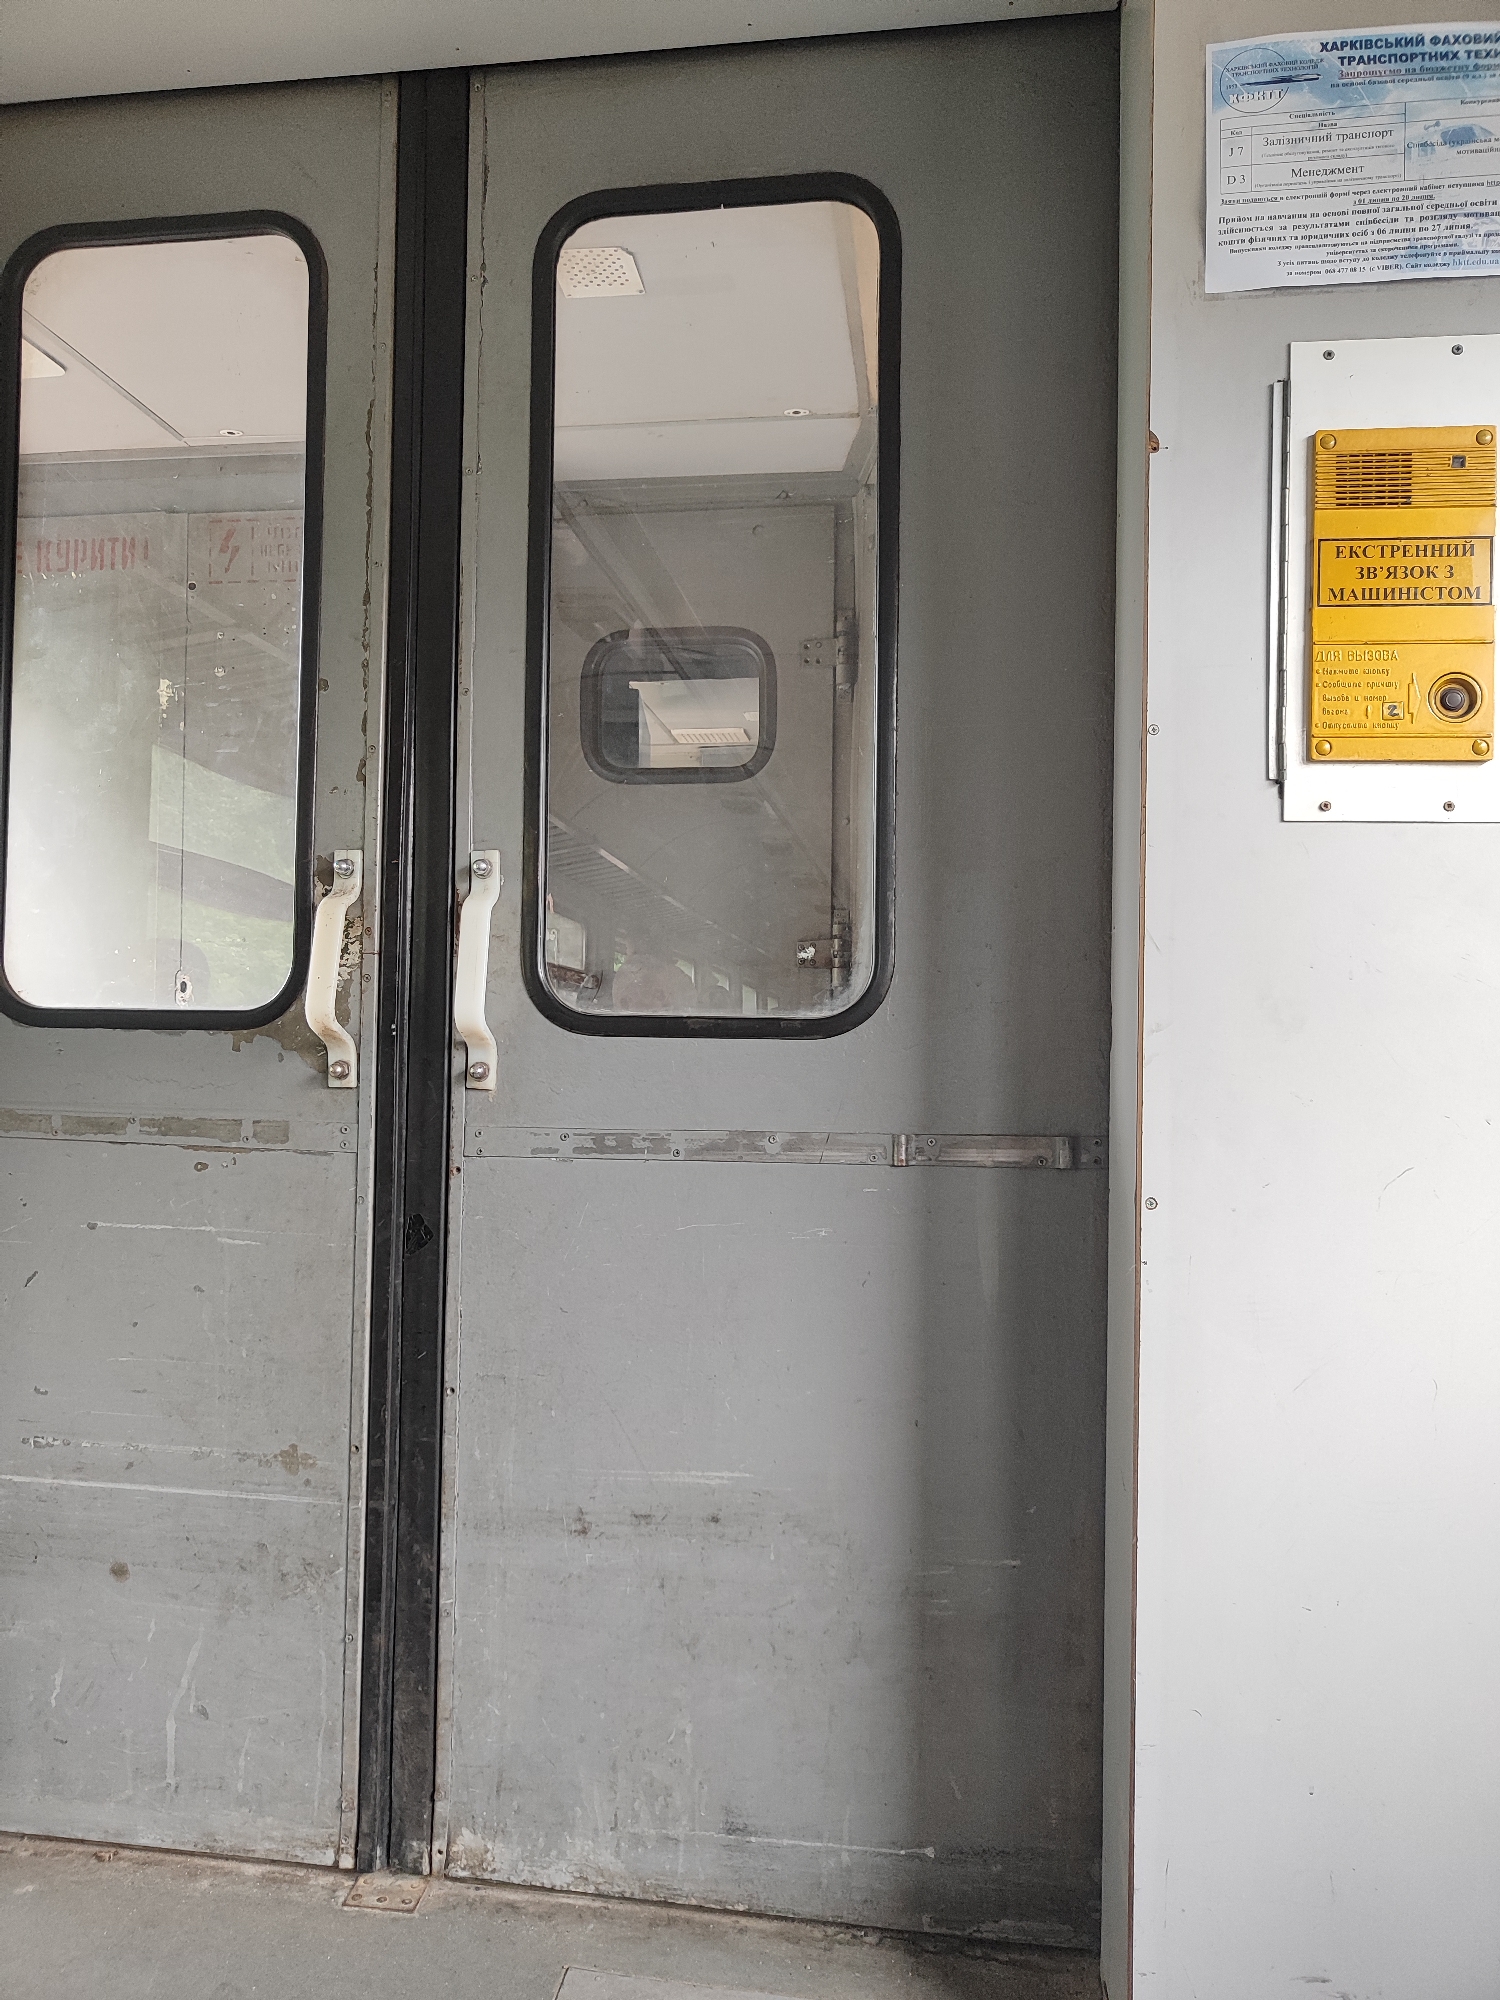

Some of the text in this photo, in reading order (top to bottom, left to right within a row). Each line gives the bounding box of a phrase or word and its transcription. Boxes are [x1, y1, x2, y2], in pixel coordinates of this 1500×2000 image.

[1319, 34, 1425, 52] ХАРКІВСЬКИЙ
[1338, 50, 1460, 66] ТРАНСПОРТНИХ
[1338, 67, 1402, 79] Запрошуємо
[1262, 130, 1394, 146] Залізничний транспорт
[1237, 146, 1244, 156] 7
[1226, 174, 1246, 185] D 3
[1291, 165, 1365, 178] Менеджмент
[1218, 215, 1252, 225] Прийом
[1267, 211, 1308, 220] навчання
[1322, 209, 1349, 217] основі
[1351, 206, 1380, 216] повної
[1382, 203, 1424, 214] загальної
[1426, 200, 1468, 210] середньої
[1469, 198, 1498, 207] освіти
[1218, 225, 1274, 235] здійснюється
[1292, 221, 1350, 231] результатами
[1355, 215, 1399, 226] співбесіди
[1419, 213, 1458, 223] розгляду
[1218, 237, 1246, 247] кошти
[1351, 228, 1369, 238] осіб
[1376, 226, 1386, 235] 06
[1431, 223, 1441, 232] 27
[1335, 540, 1475, 559] ЕКСТРЕННИЙ
[1355, 564, 1455, 580] ЗВ’ЯЗОК З
[1327, 585, 1482, 602] МАШИНІСТОМ
[1314, 650, 1399, 662] ДЛЯ ВЫЗОВА
[1322, 680, 1362, 689] Сообщите
[1387, 704, 1400, 718] 2
[1322, 721, 1368, 731] Отпустите
